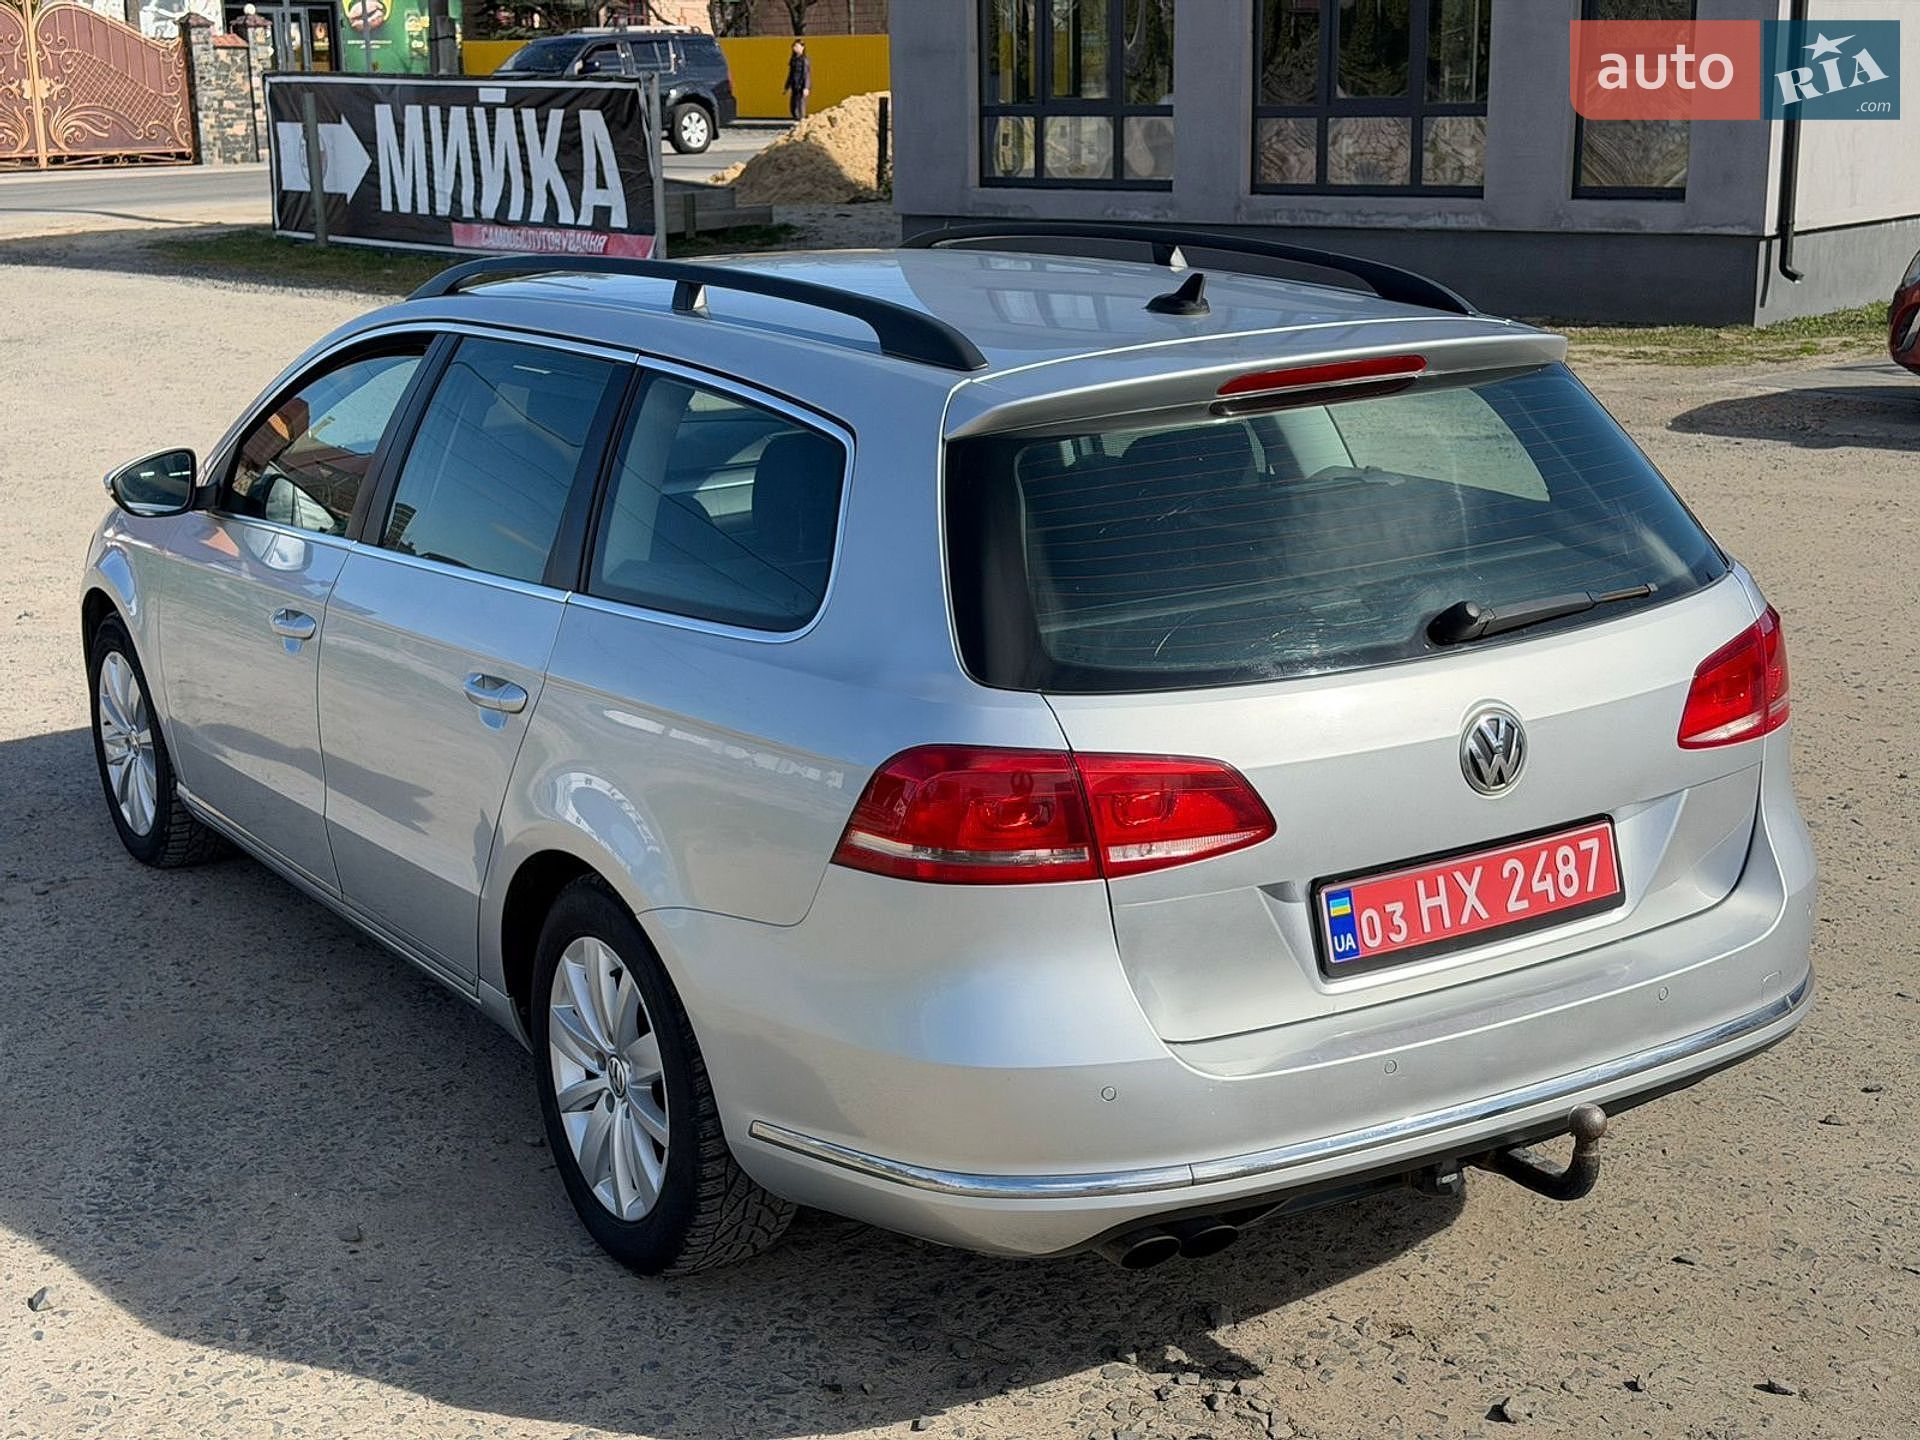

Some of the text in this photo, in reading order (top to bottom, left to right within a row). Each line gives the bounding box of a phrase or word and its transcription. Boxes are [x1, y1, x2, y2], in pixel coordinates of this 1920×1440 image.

[374, 87, 628, 229] МИЙКА
[1334, 933, 1357, 952] UA
[1360, 837, 1600, 949] 03 HX 2487
